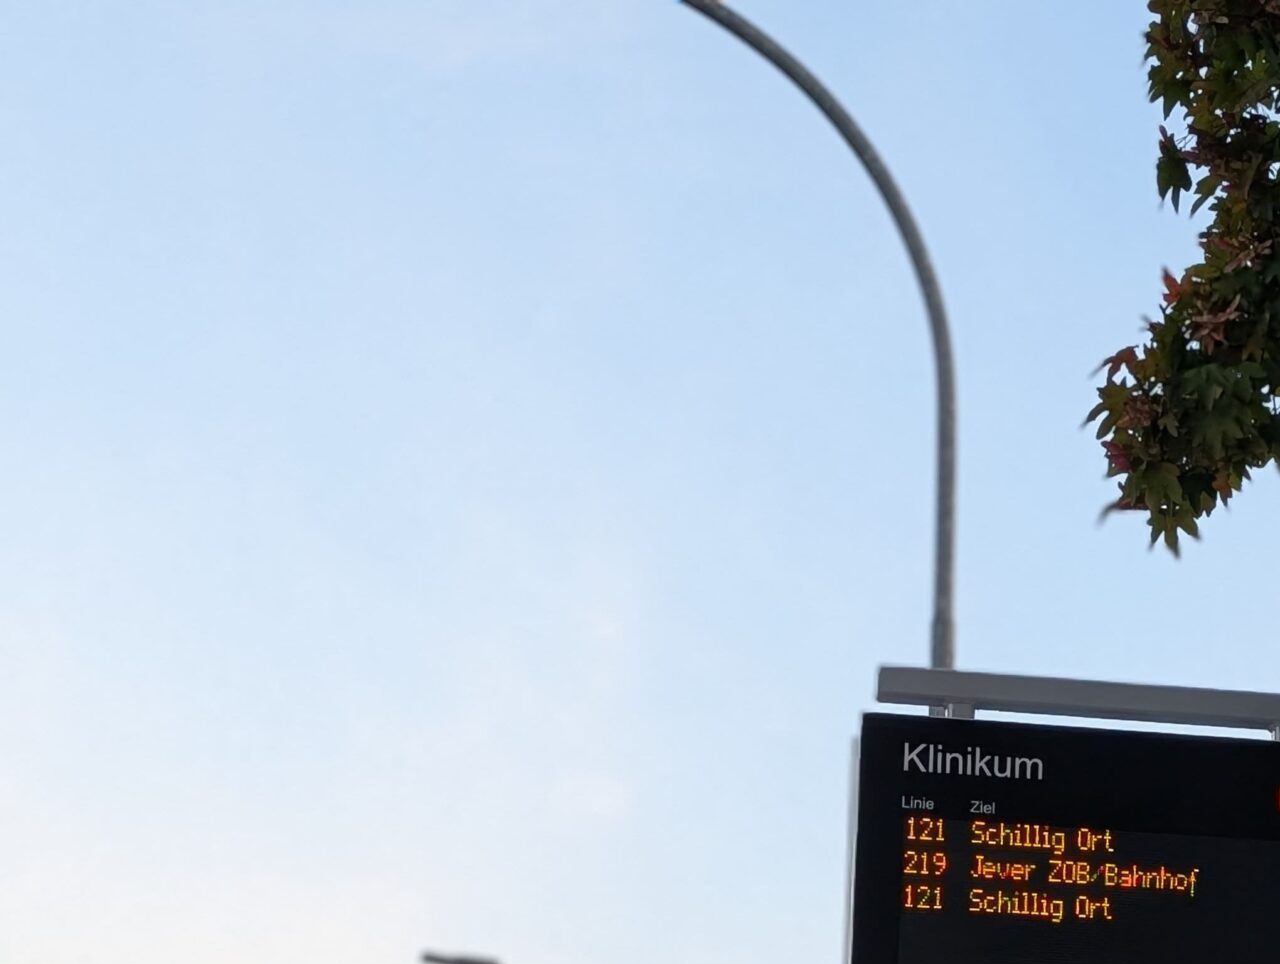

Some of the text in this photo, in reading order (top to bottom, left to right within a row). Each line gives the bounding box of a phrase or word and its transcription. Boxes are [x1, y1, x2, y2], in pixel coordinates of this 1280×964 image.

[903, 742, 1044, 780] Klinikum
[901, 795, 996, 815] Linie Ziel
[907, 816, 945, 841] 121
[970, 821, 1065, 855] Schillig
[1077, 827, 1114, 852] Ort
[903, 851, 947, 875] 219
[970, 855, 1036, 881] Jever
[904, 885, 942, 909] 121
[968, 889, 1063, 923] Schillig
[1075, 896, 1112, 919] Ort
